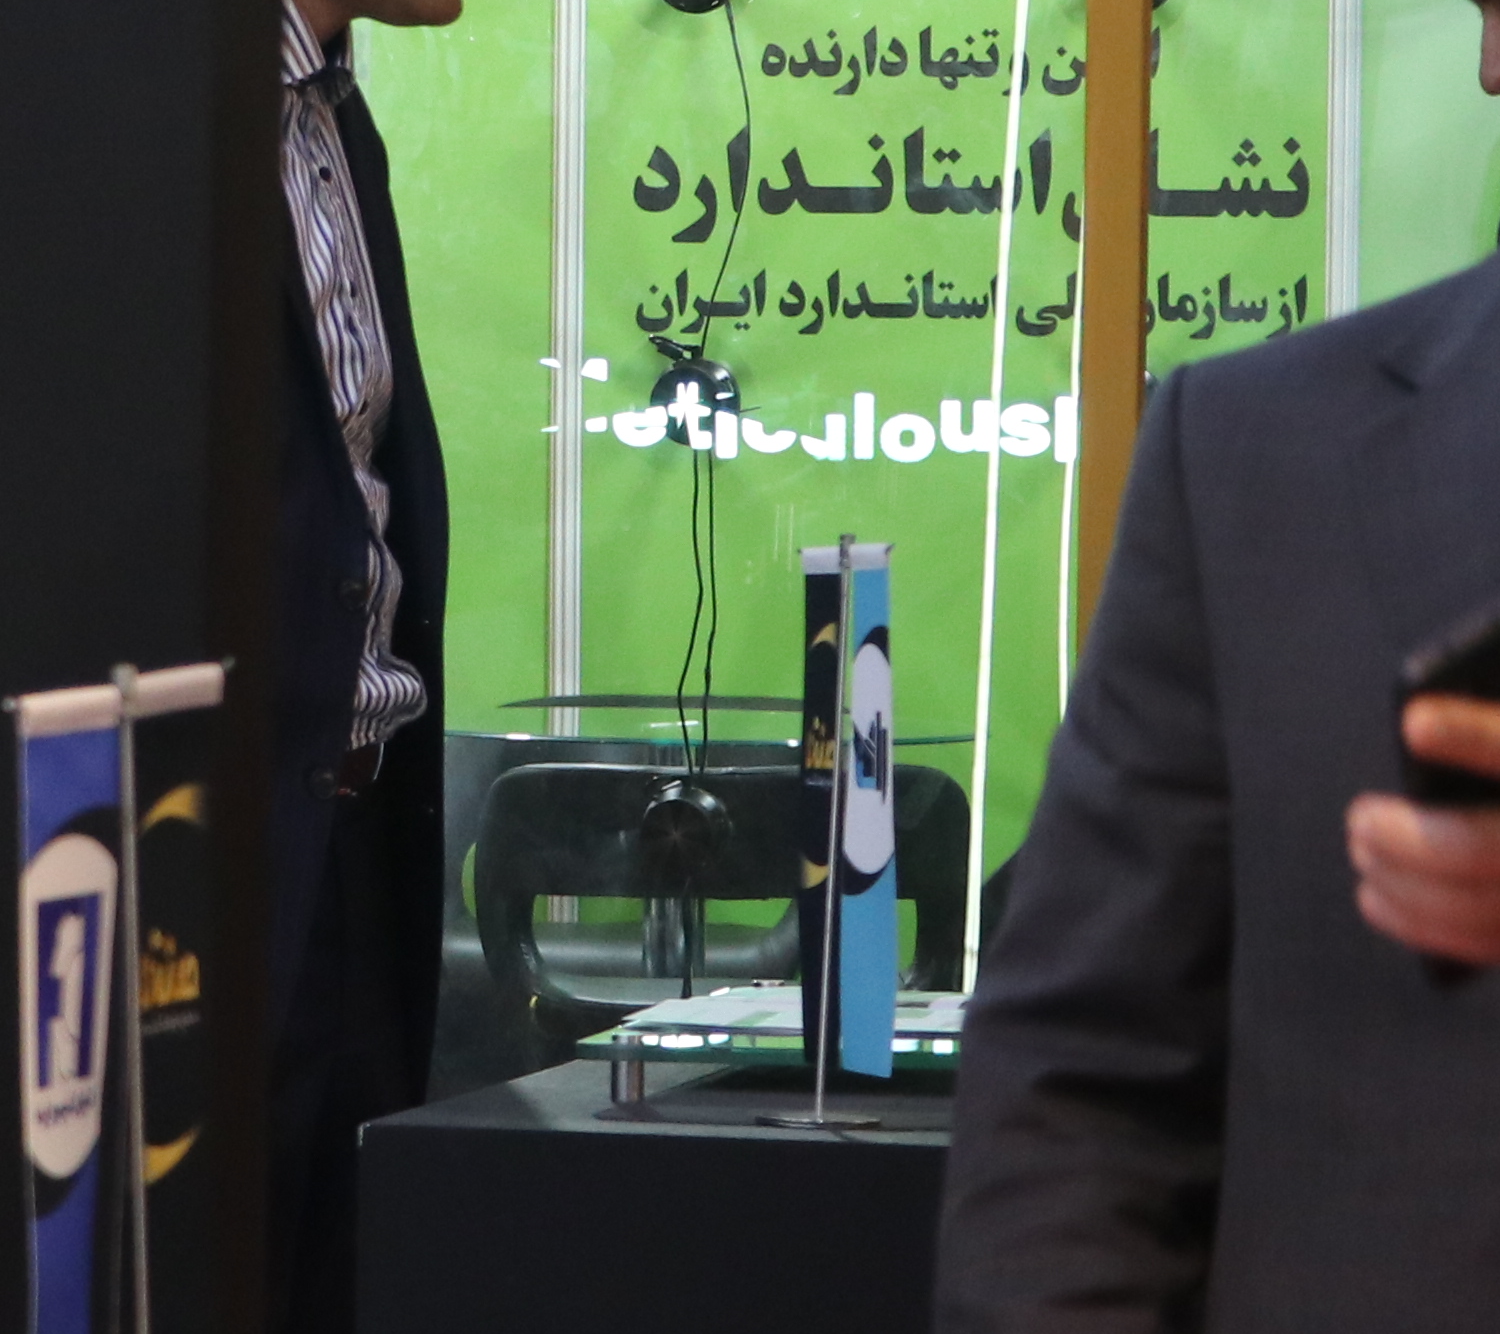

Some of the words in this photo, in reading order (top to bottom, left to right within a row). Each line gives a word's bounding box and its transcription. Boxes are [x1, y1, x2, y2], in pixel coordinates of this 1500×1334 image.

[761, 25, 908, 96] دارنده
[633, 125, 1053, 244] استاندارد
[636, 267, 767, 333] ایران
[778, 267, 999, 335] استاندارد
[1144, 272, 1267, 340] سازما
